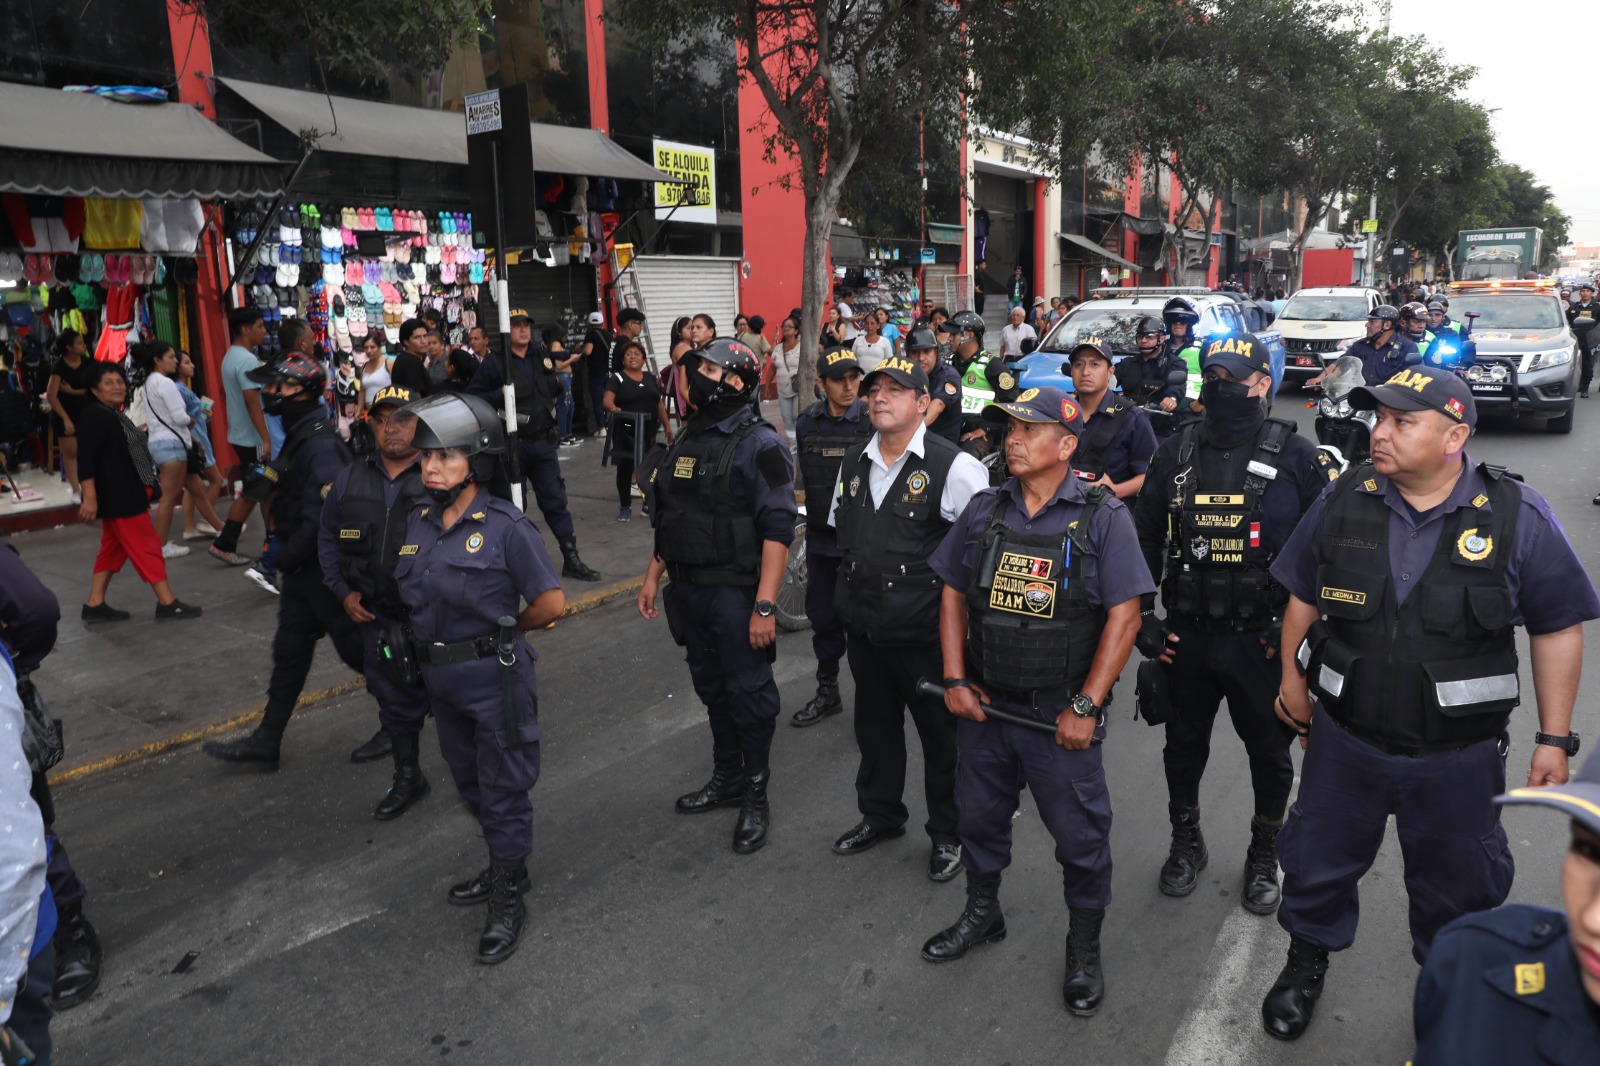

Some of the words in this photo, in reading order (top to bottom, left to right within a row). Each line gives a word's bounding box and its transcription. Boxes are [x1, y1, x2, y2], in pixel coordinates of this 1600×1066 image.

[469, 101, 500, 122] AMARRES
[659, 150, 670, 168] SE
[673, 153, 710, 173] ALQUILA
[1466, 232, 1504, 242] ESCUADRON
[1505, 231, 1527, 240] VERDE
[1207, 337, 1253, 358] IRAM
[826, 349, 858, 366] IRAM
[874, 356, 914, 375] IRAM
[374, 386, 410, 404] IRAM
[1007, 404, 1033, 417] M.P.T.
[1211, 538, 1244, 551] ESCUADRON
[1212, 553, 1243, 562] IRAM
[994, 576, 1025, 594] ESCUADRON
[992, 591, 1023, 609] IRAM
[1331, 591, 1354, 600] MEDINA
